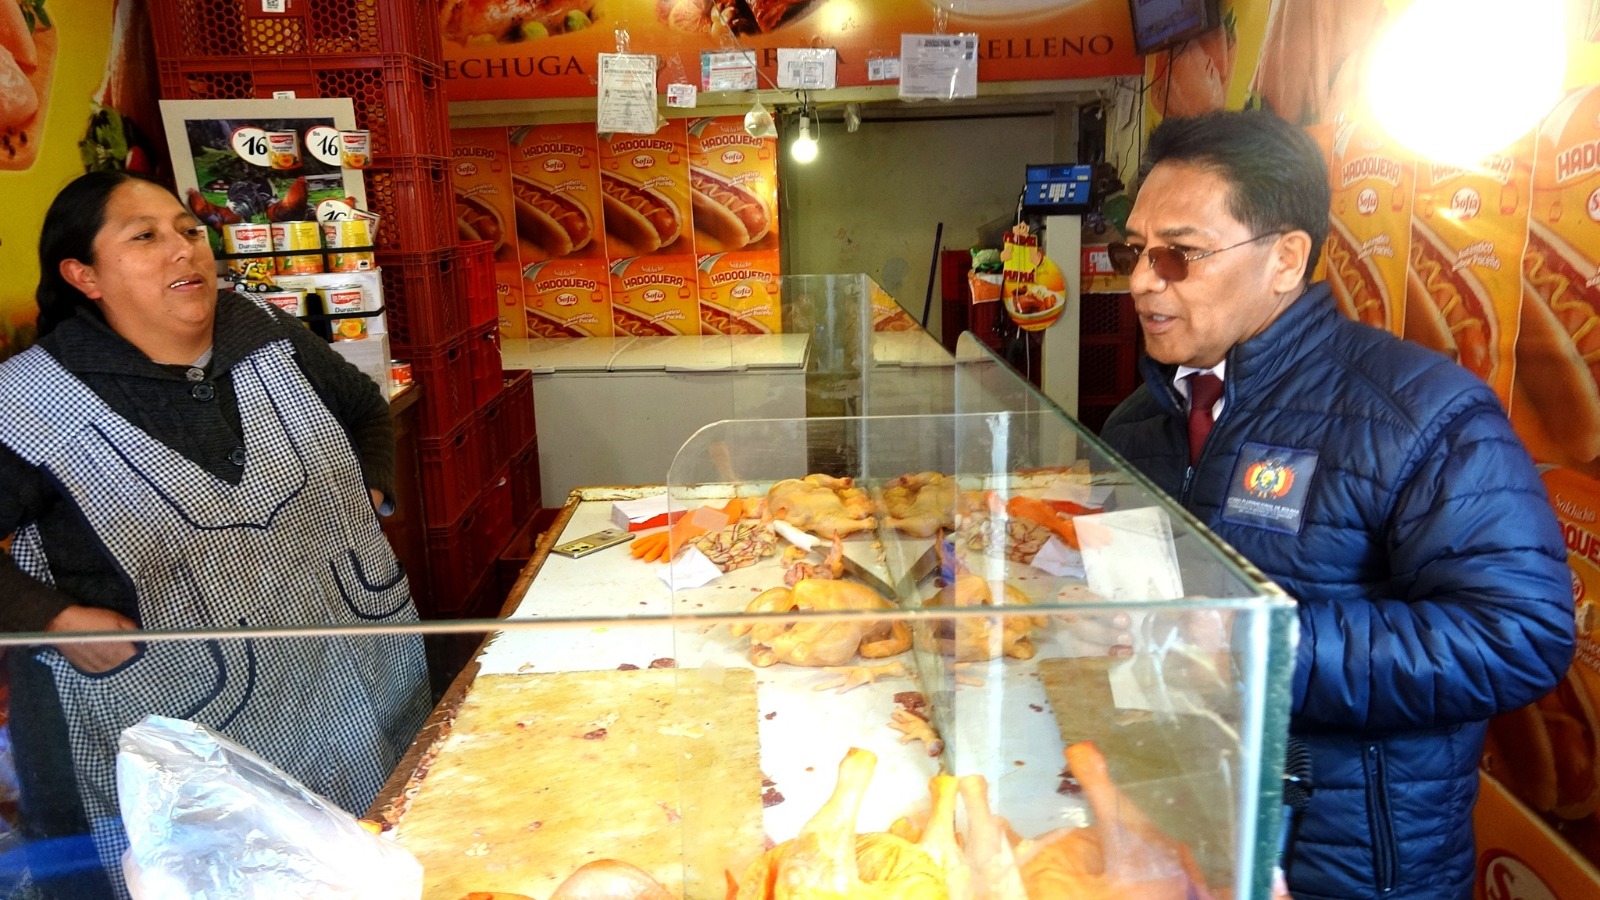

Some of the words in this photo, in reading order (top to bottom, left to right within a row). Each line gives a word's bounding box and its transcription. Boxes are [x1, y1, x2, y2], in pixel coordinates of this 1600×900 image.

[444, 55, 584, 80] ECHUGA
[242, 135, 268, 155] 16
[317, 135, 339, 156] 16
[522, 143, 584, 158] HADOQUERA
[612, 139, 674, 154] HADOQUERA
[1342, 157, 1400, 186] HADOQUERA
[536, 278, 596, 293] HADOQUERA
[623, 274, 684, 289] HADOQUERA
[710, 270, 772, 286] HADOQUERA
[644, 291, 664, 301] Sofía
